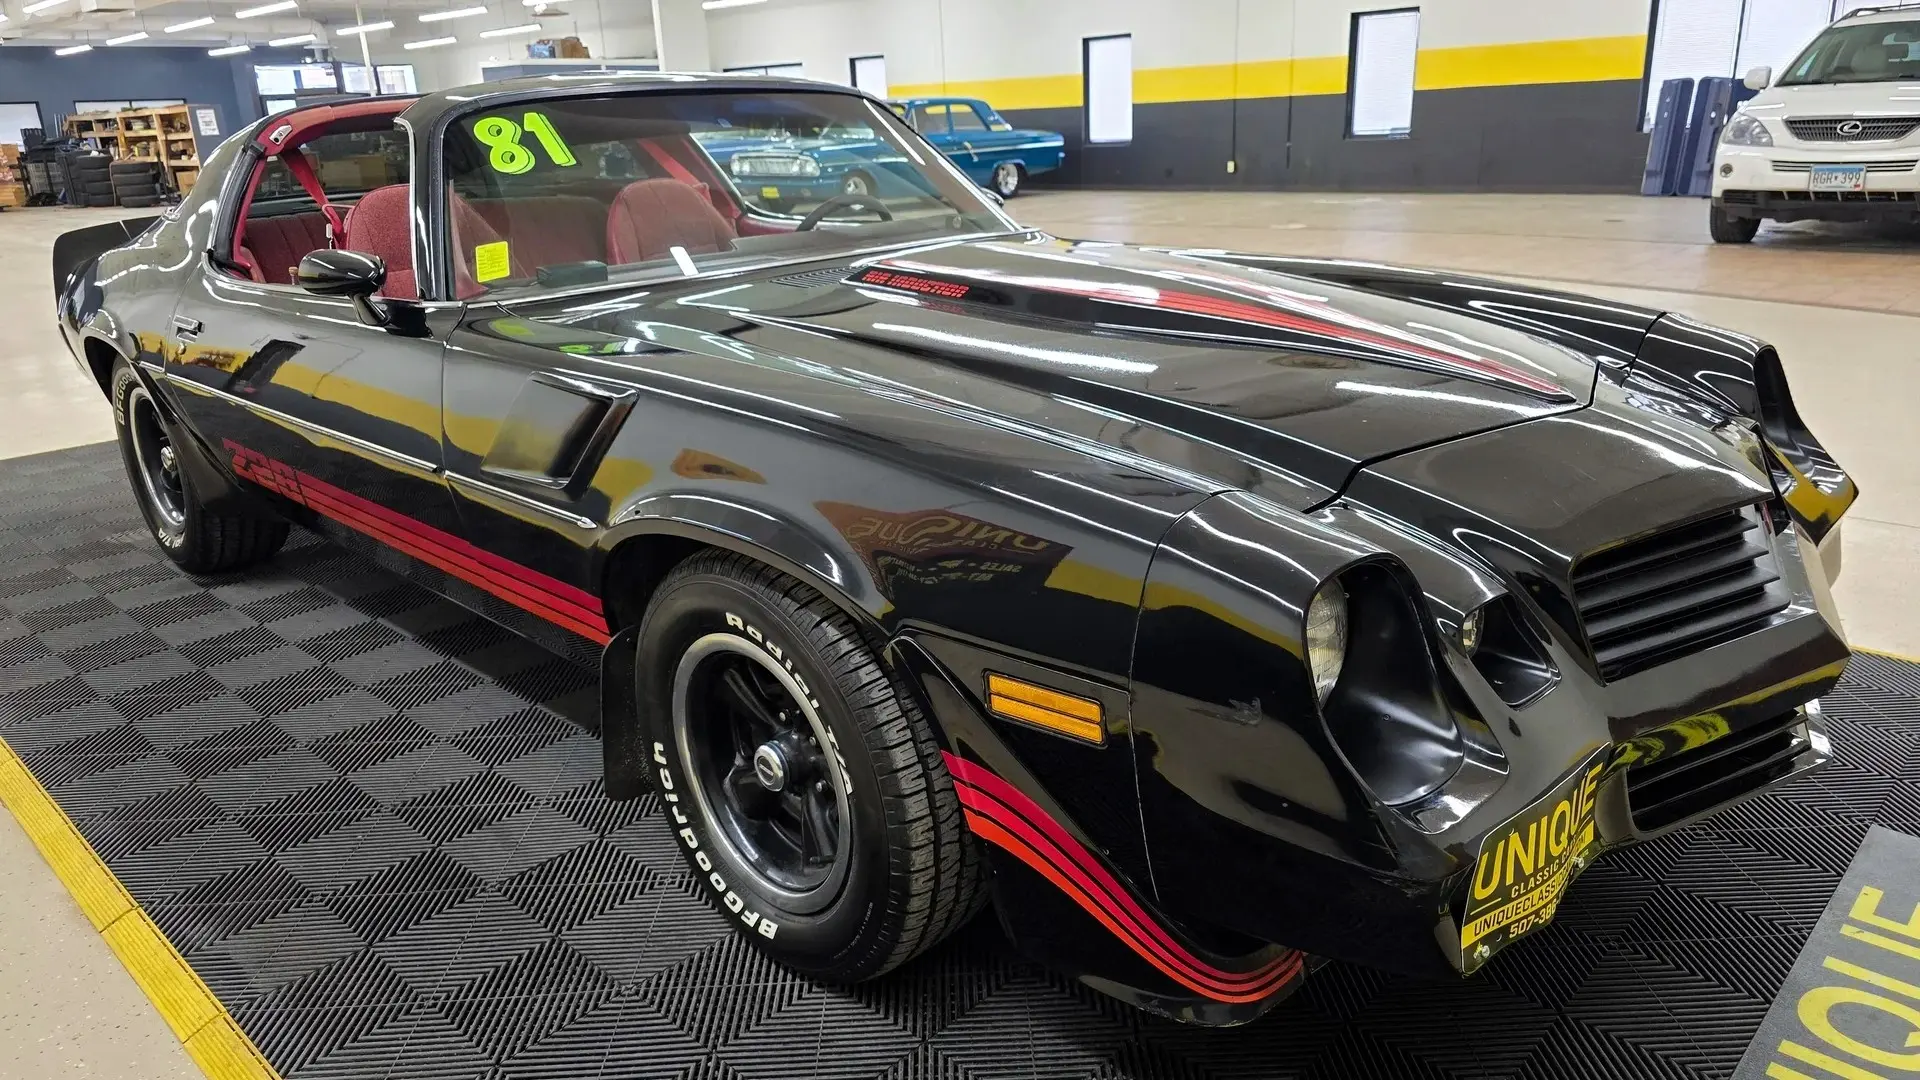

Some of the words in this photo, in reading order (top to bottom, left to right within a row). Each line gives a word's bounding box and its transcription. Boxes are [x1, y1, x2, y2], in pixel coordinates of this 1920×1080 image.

[473, 112, 577, 175] 81
[1812, 171, 1834, 185] RGR
[1840, 171, 1861, 185] 399
[887, 275, 970, 298] INDUCTION
[653, 741, 779, 940] BFGoodrich
[1474, 762, 1603, 900] UNIQUE
[1511, 859, 1559, 898] CLASSIC
